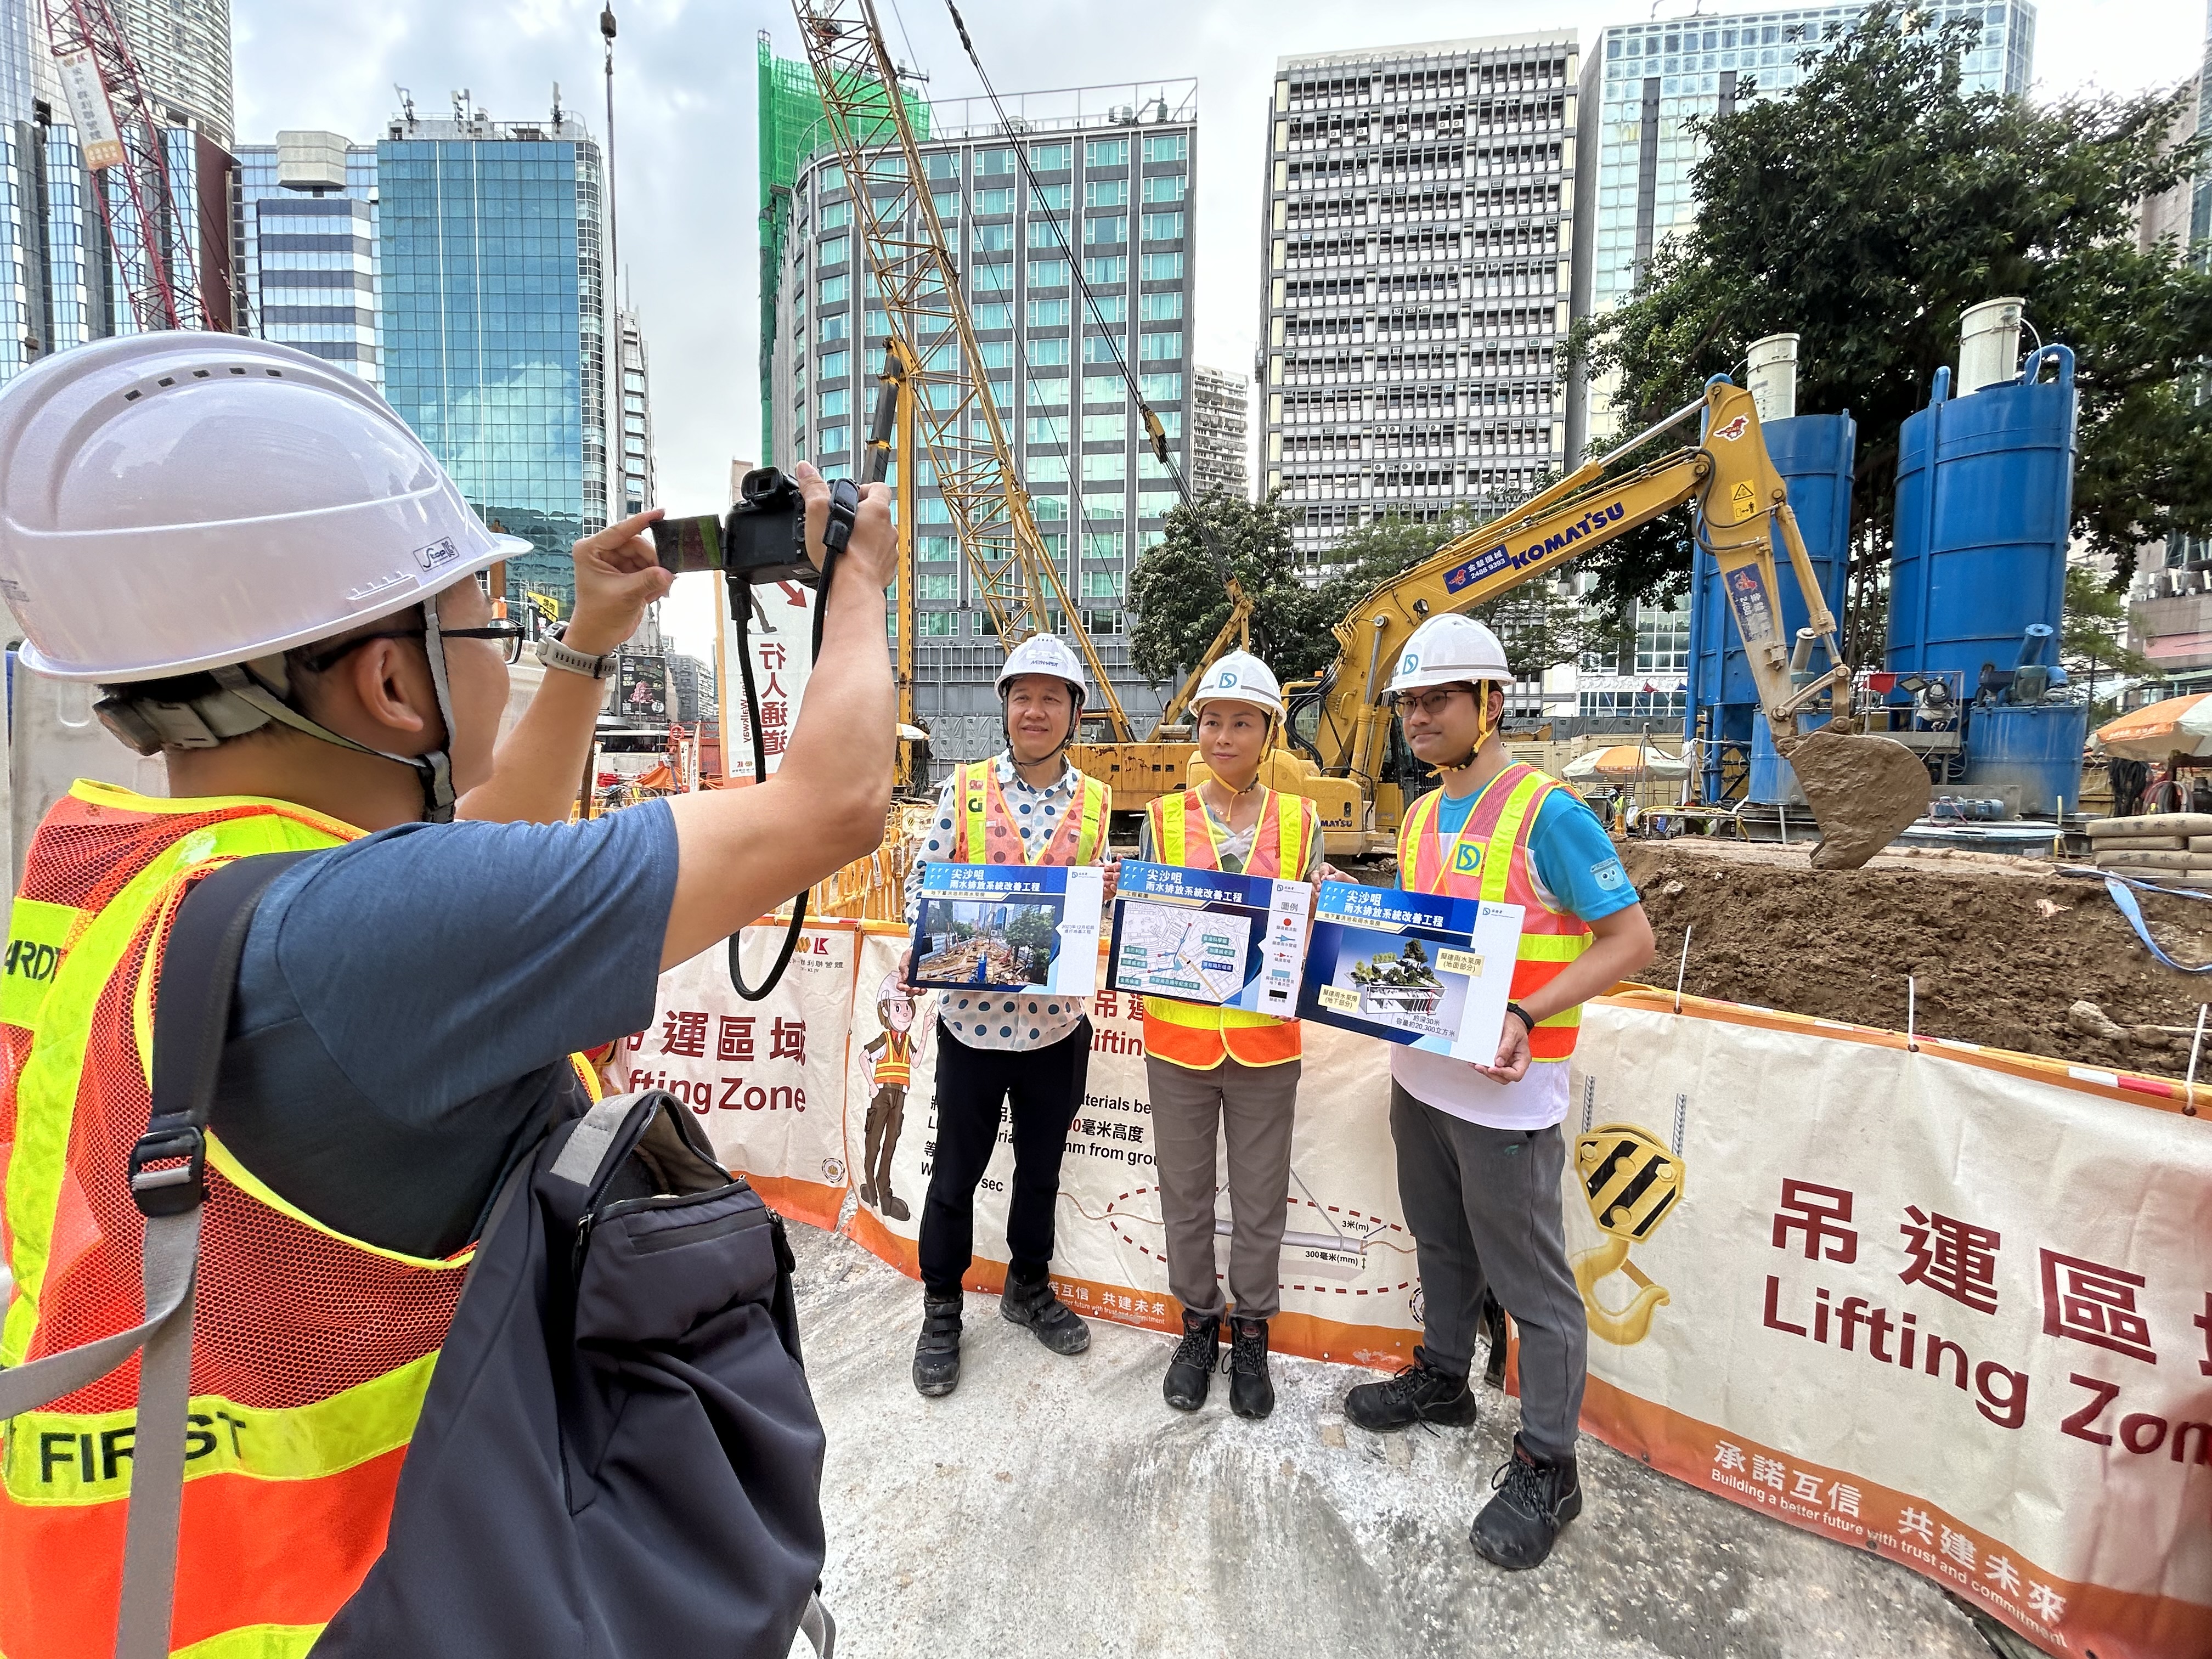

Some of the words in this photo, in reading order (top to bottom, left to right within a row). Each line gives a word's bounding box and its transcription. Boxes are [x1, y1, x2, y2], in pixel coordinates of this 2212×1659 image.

[1511, 501, 1624, 569] KOMATSU
[1470, 566, 1488, 579] 2488
[1488, 558, 1506, 572] 9393
[951, 869, 984, 880] 尖沙咀
[1147, 868, 1182, 884] 尖沙咀
[950, 879, 1041, 891] 雨水排放系統改善工程
[1146, 881, 1243, 902] 雨水排放系統改善工程
[1281, 902, 1299, 911] 圖例
[1346, 890, 1381, 906] 尖沙咀
[1344, 902, 1444, 928] 雨水排放系統改善工程
[1441, 952, 1482, 966] 擬建雨水泵房
[1443, 961, 1476, 973] (地面部分)
[1322, 989, 1358, 1003] 擬建雨水泵房
[1325, 997, 1353, 1009] (地下部分)
[1413, 1015, 1440, 1026] 約深30米
[1089, 1028, 1147, 1063] iftin
[627, 1066, 712, 1115] fting
[718, 1078, 806, 1112] Zone
[1082, 1093, 1130, 1111] terials
[1068, 1118, 1144, 1143] 0毫米高度
[1090, 1142, 1124, 1160] from
[980, 1178, 1004, 1192] sec
[1342, 1220, 1369, 1233] 3米(m)
[1305, 1250, 1358, 1267] 300毫米(mm)
[1771, 1178, 2212, 1376] 吊運區
[1074, 1300, 1091, 1310] future
[1102, 1291, 1165, 1316] 共建未來
[1762, 1274, 2029, 1429] Lifting
[1713, 1440, 1862, 1519] 承諾互信
[1898, 1506, 2067, 1623] 共建未來
[1712, 1468, 1765, 1502] Building
[1768, 1494, 1777, 1504] a
[1780, 1496, 1820, 1521] better
[1822, 1512, 1864, 1536] future
[1867, 1528, 1898, 1548] with
[1900, 1538, 1937, 1567] trust
[1939, 1561, 1968, 1584] and
[1971, 1580, 2068, 1648] commitment
